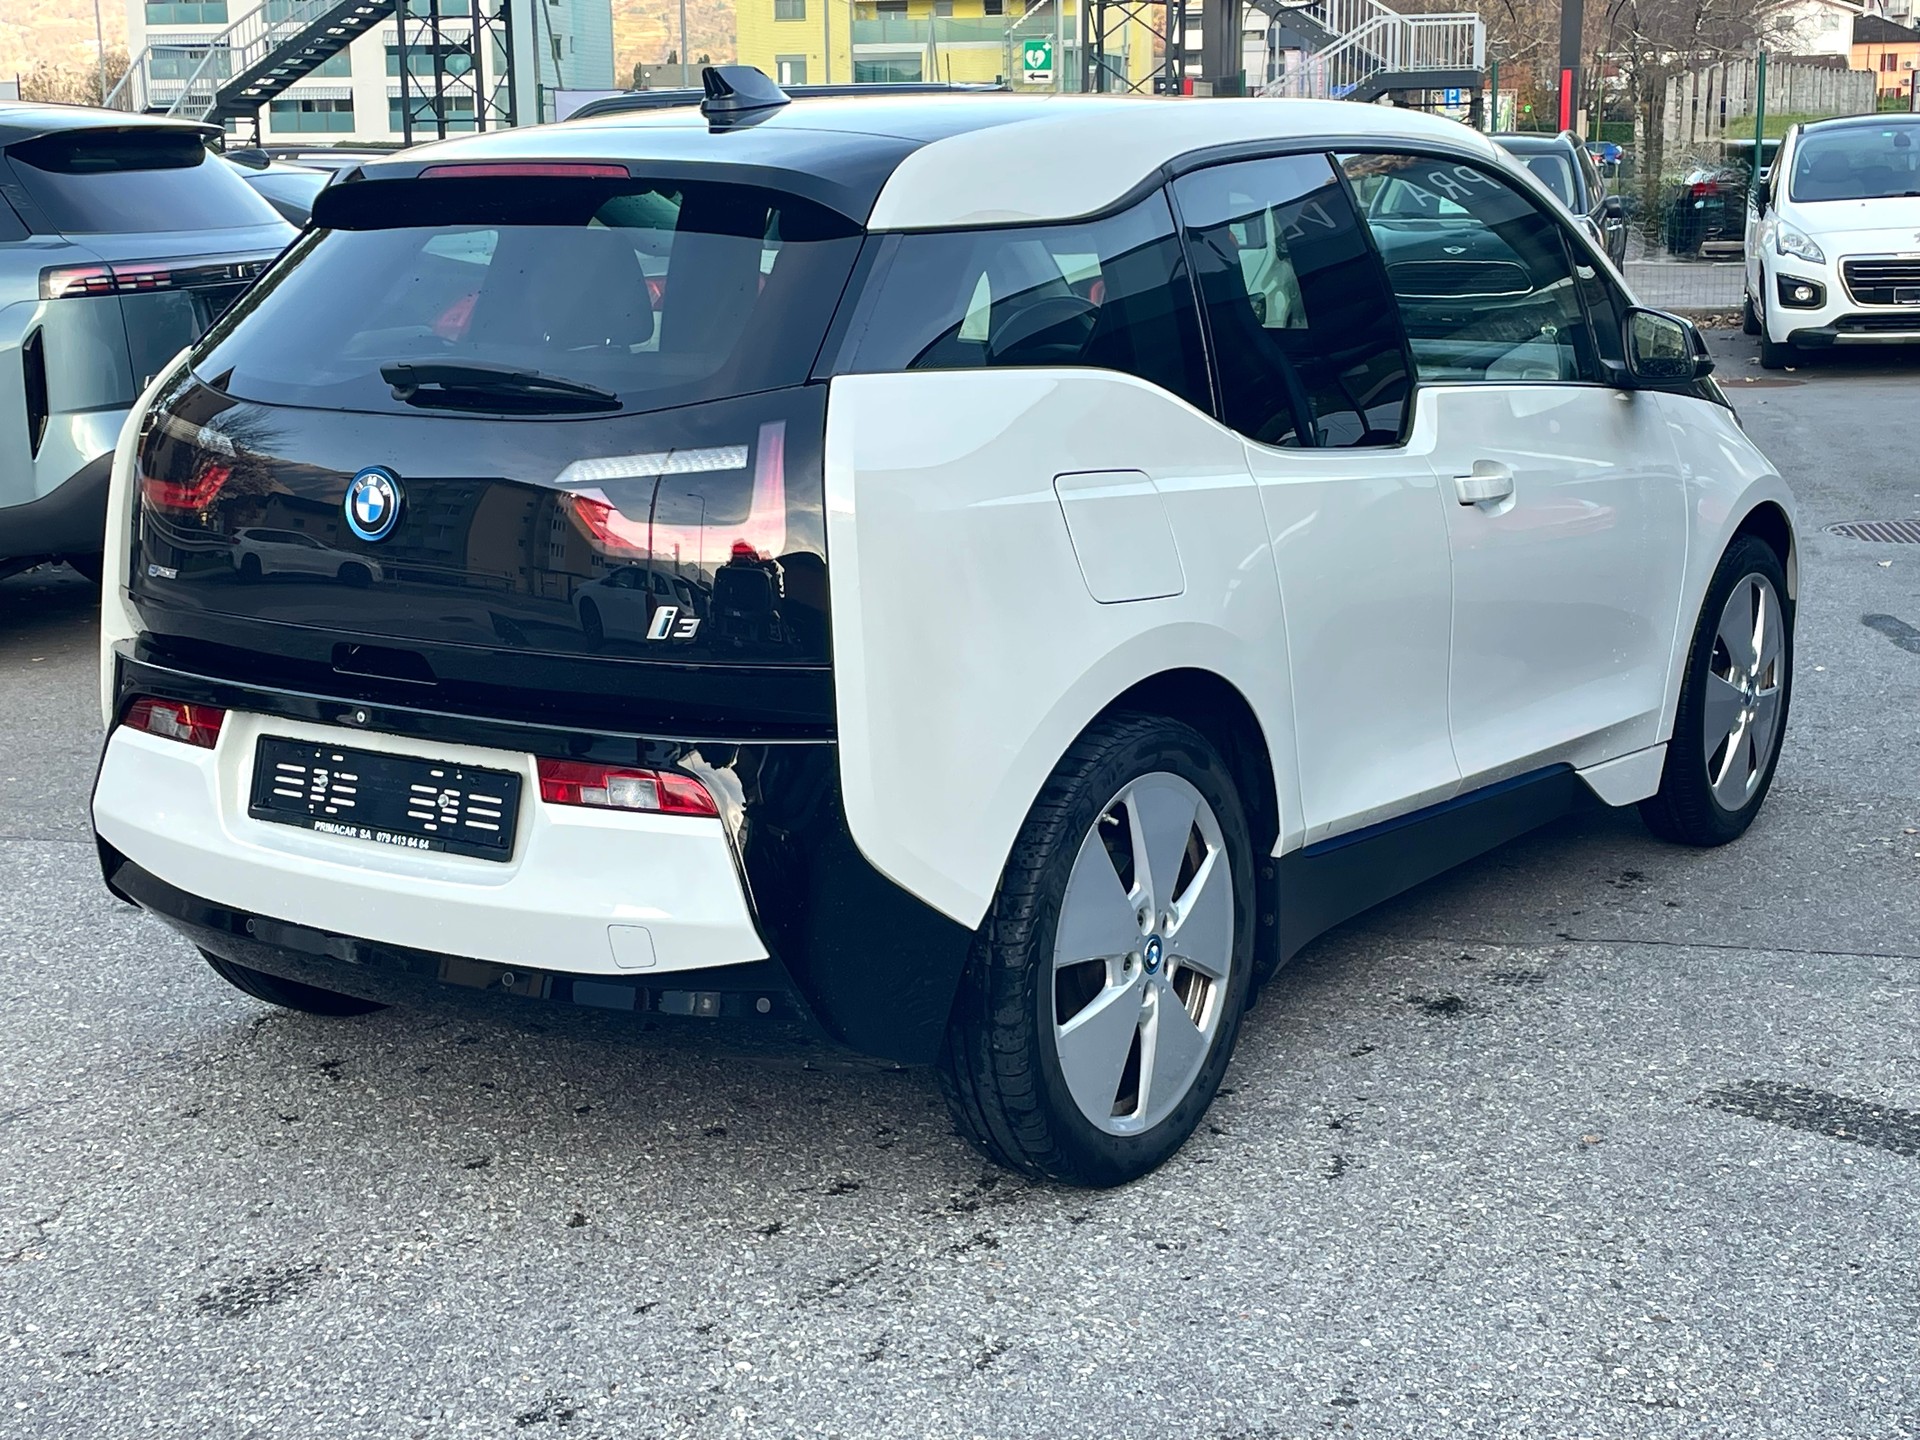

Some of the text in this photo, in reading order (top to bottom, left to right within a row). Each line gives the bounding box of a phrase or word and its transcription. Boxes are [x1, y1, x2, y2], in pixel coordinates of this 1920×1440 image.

[355, 475, 390, 497] BMW
[646, 605, 701, 640] i3
[314, 821, 430, 850] PRIMACAR SA 079 413 64 64
